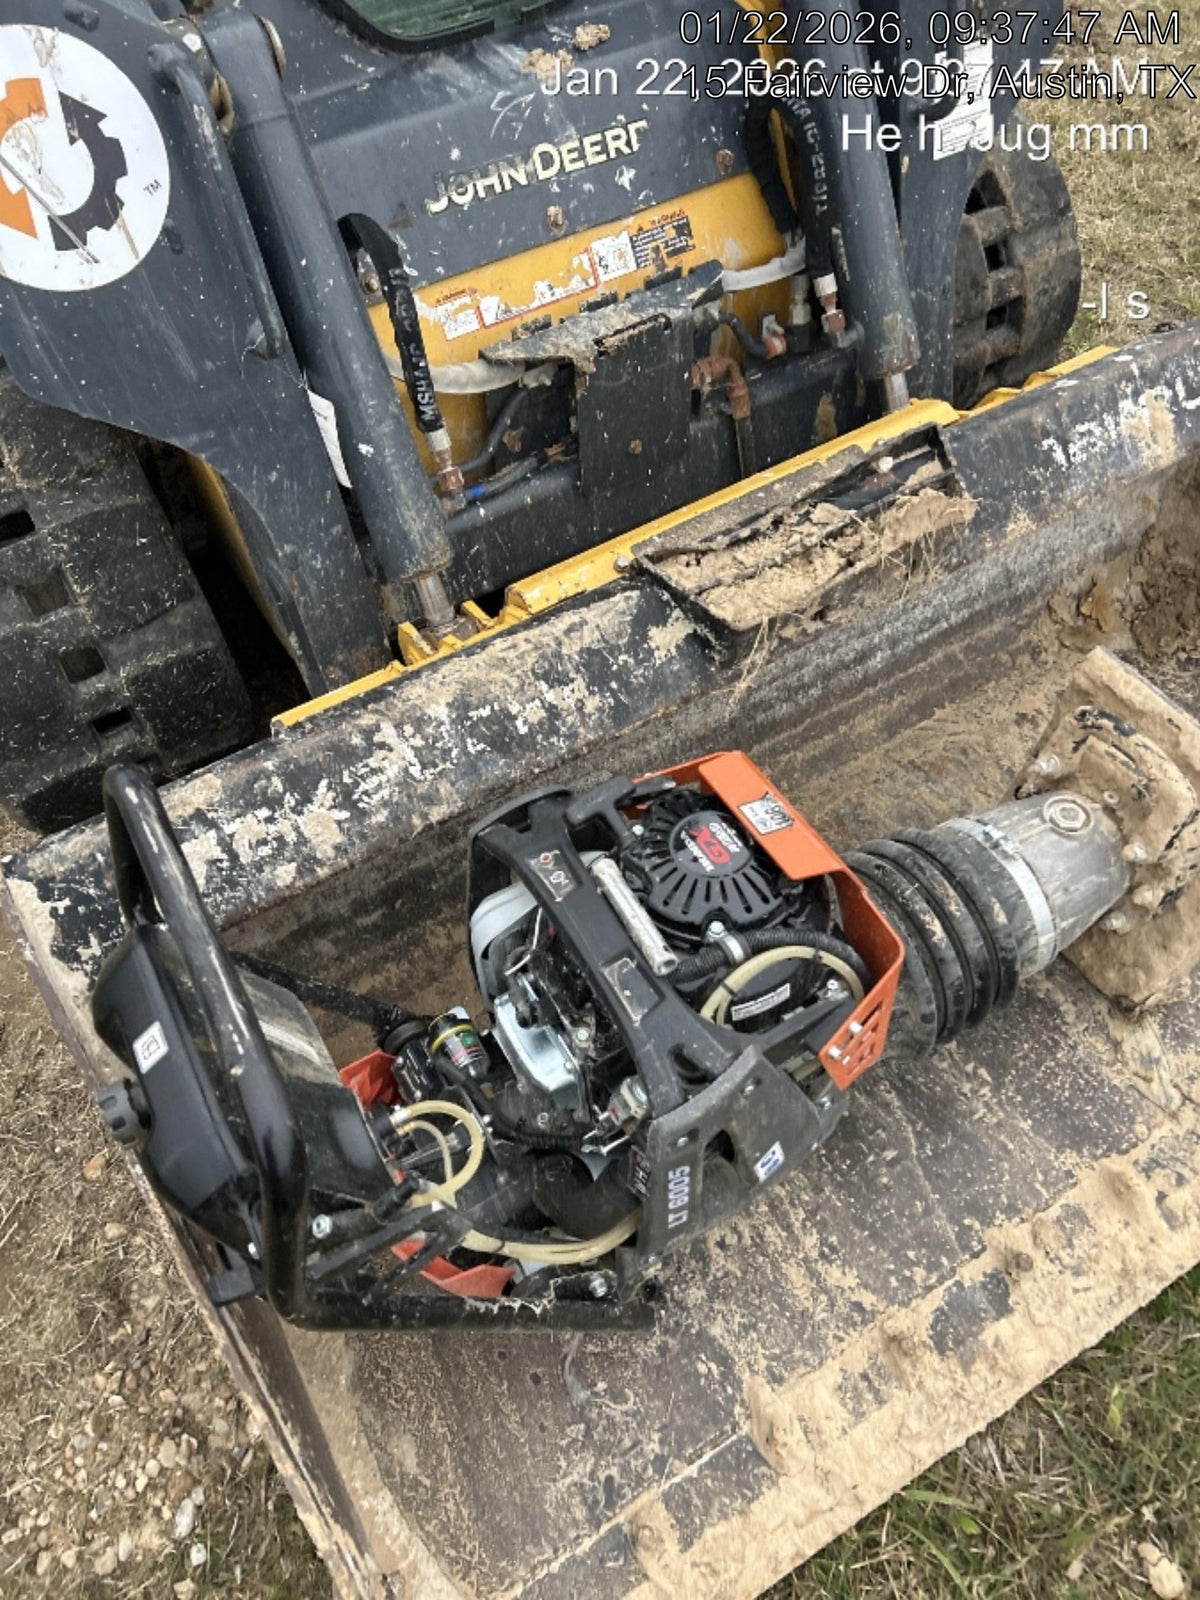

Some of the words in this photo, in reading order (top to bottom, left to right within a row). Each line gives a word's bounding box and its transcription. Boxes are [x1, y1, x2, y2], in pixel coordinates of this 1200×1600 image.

[425, 156, 530, 215] JOHN
[668, 1165, 690, 1210] 6005
[668, 1209, 689, 1230] LT
